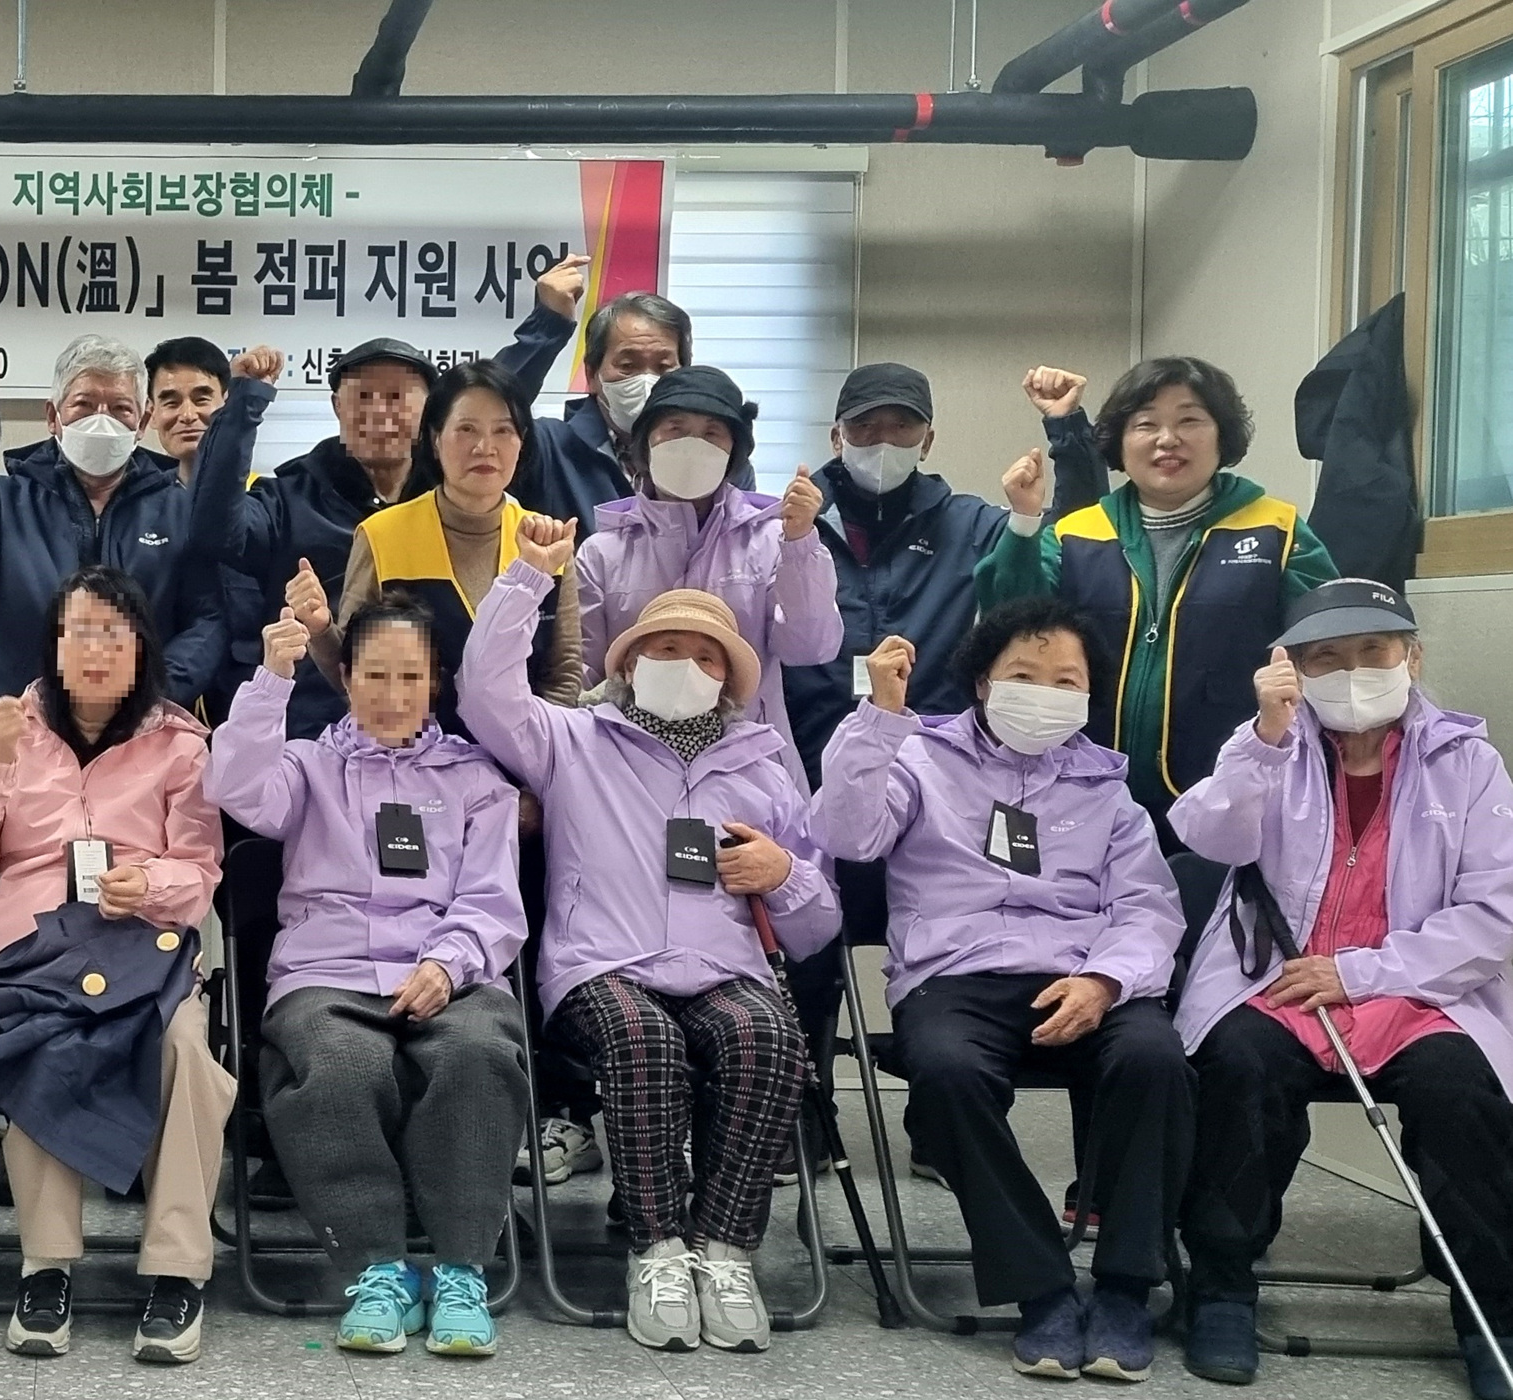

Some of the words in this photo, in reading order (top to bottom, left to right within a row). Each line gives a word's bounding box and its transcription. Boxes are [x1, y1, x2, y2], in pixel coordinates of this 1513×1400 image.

[12, 170, 334, 218] 지역사회보장협의체
[190, 239, 238, 316] 봄
[253, 238, 347, 318] 점퍼
[364, 239, 457, 318] 지원
[1371, 591, 1396, 605] FILA
[387, 843, 420, 851] EIDER
[674, 851, 709, 863] EIDER
